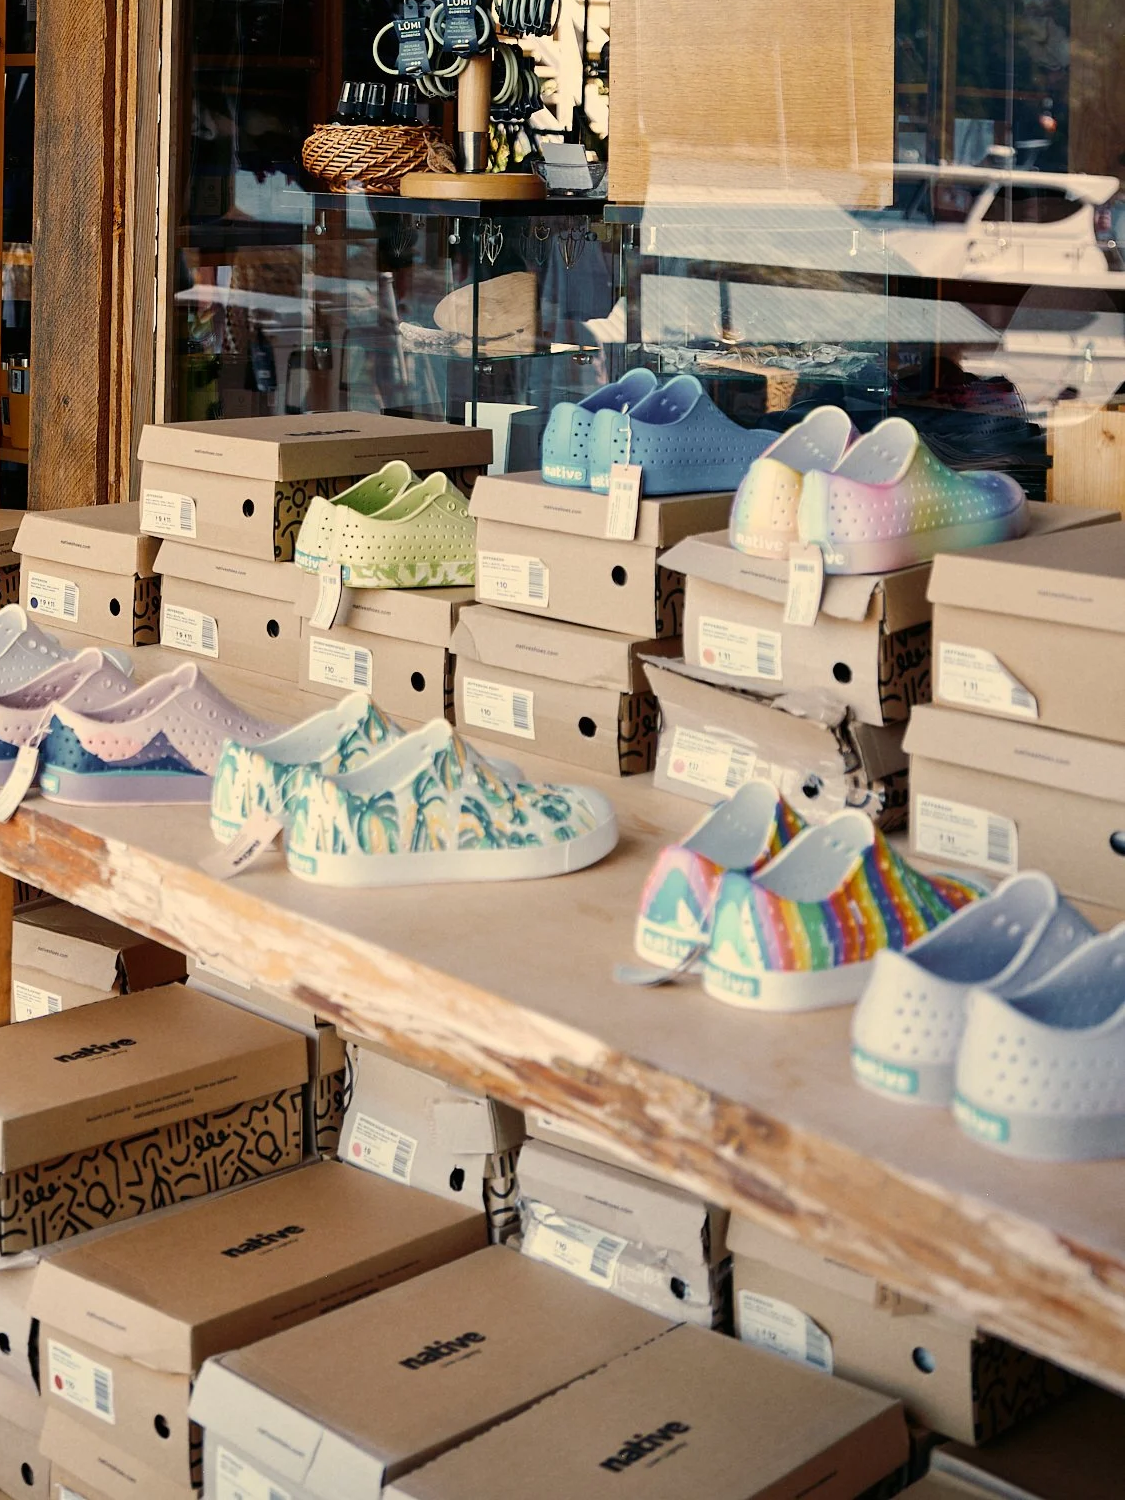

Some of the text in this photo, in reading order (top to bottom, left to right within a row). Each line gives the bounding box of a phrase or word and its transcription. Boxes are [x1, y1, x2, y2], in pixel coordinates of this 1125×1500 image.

[544, 465, 583, 481] native
[590, 475, 611, 488] nati
[736, 532, 784, 552] native
[295, 555, 320, 570] nativ
[52, 1038, 137, 1064] native
[220, 1225, 305, 1259] native
[399, 1331, 486, 1371] native
[600, 1419, 691, 1474] native
